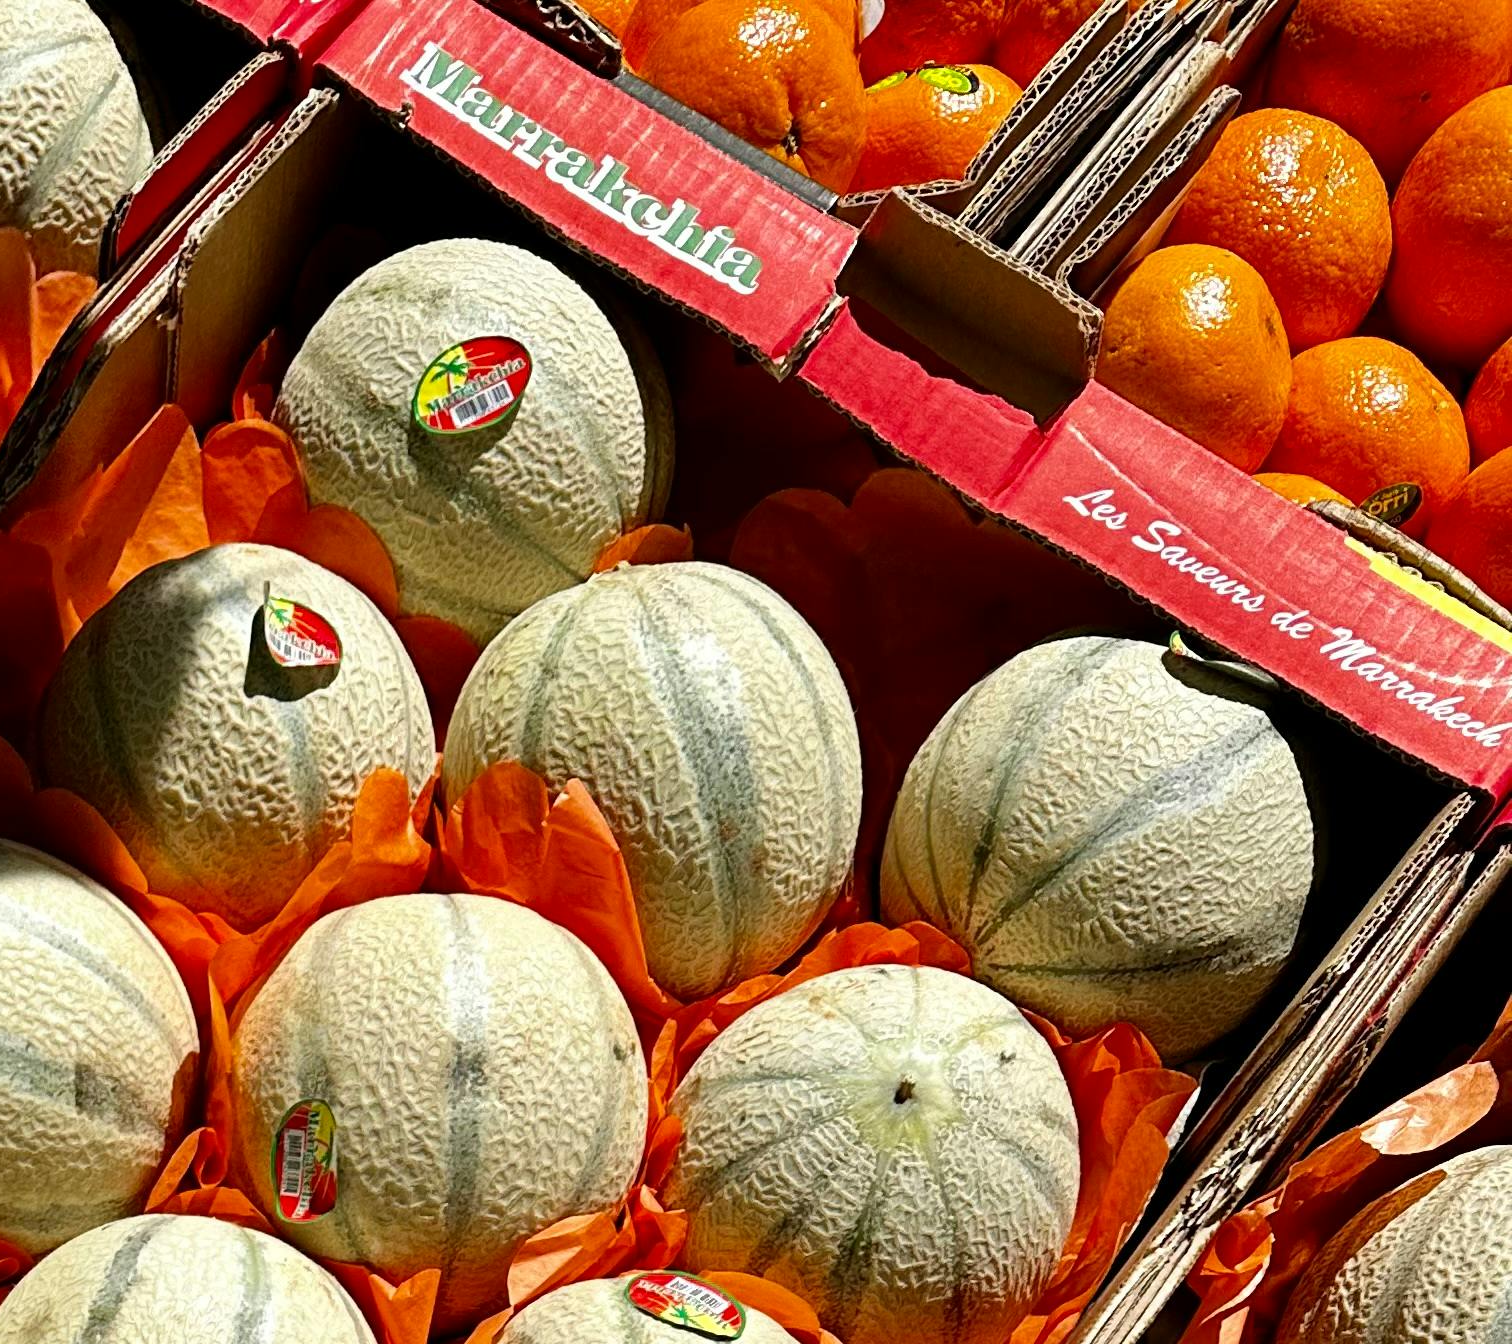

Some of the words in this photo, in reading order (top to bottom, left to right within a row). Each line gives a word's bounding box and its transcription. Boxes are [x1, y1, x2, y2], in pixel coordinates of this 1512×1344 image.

[401, 41, 761, 295] Marrakchia
[425, 357, 526, 412] Marrakchia
[1062, 488, 1128, 532] Les
[1131, 520, 1263, 614] Saveurs
[1270, 609, 1315, 641] de
[1320, 626, 1503, 748] Marrakech
